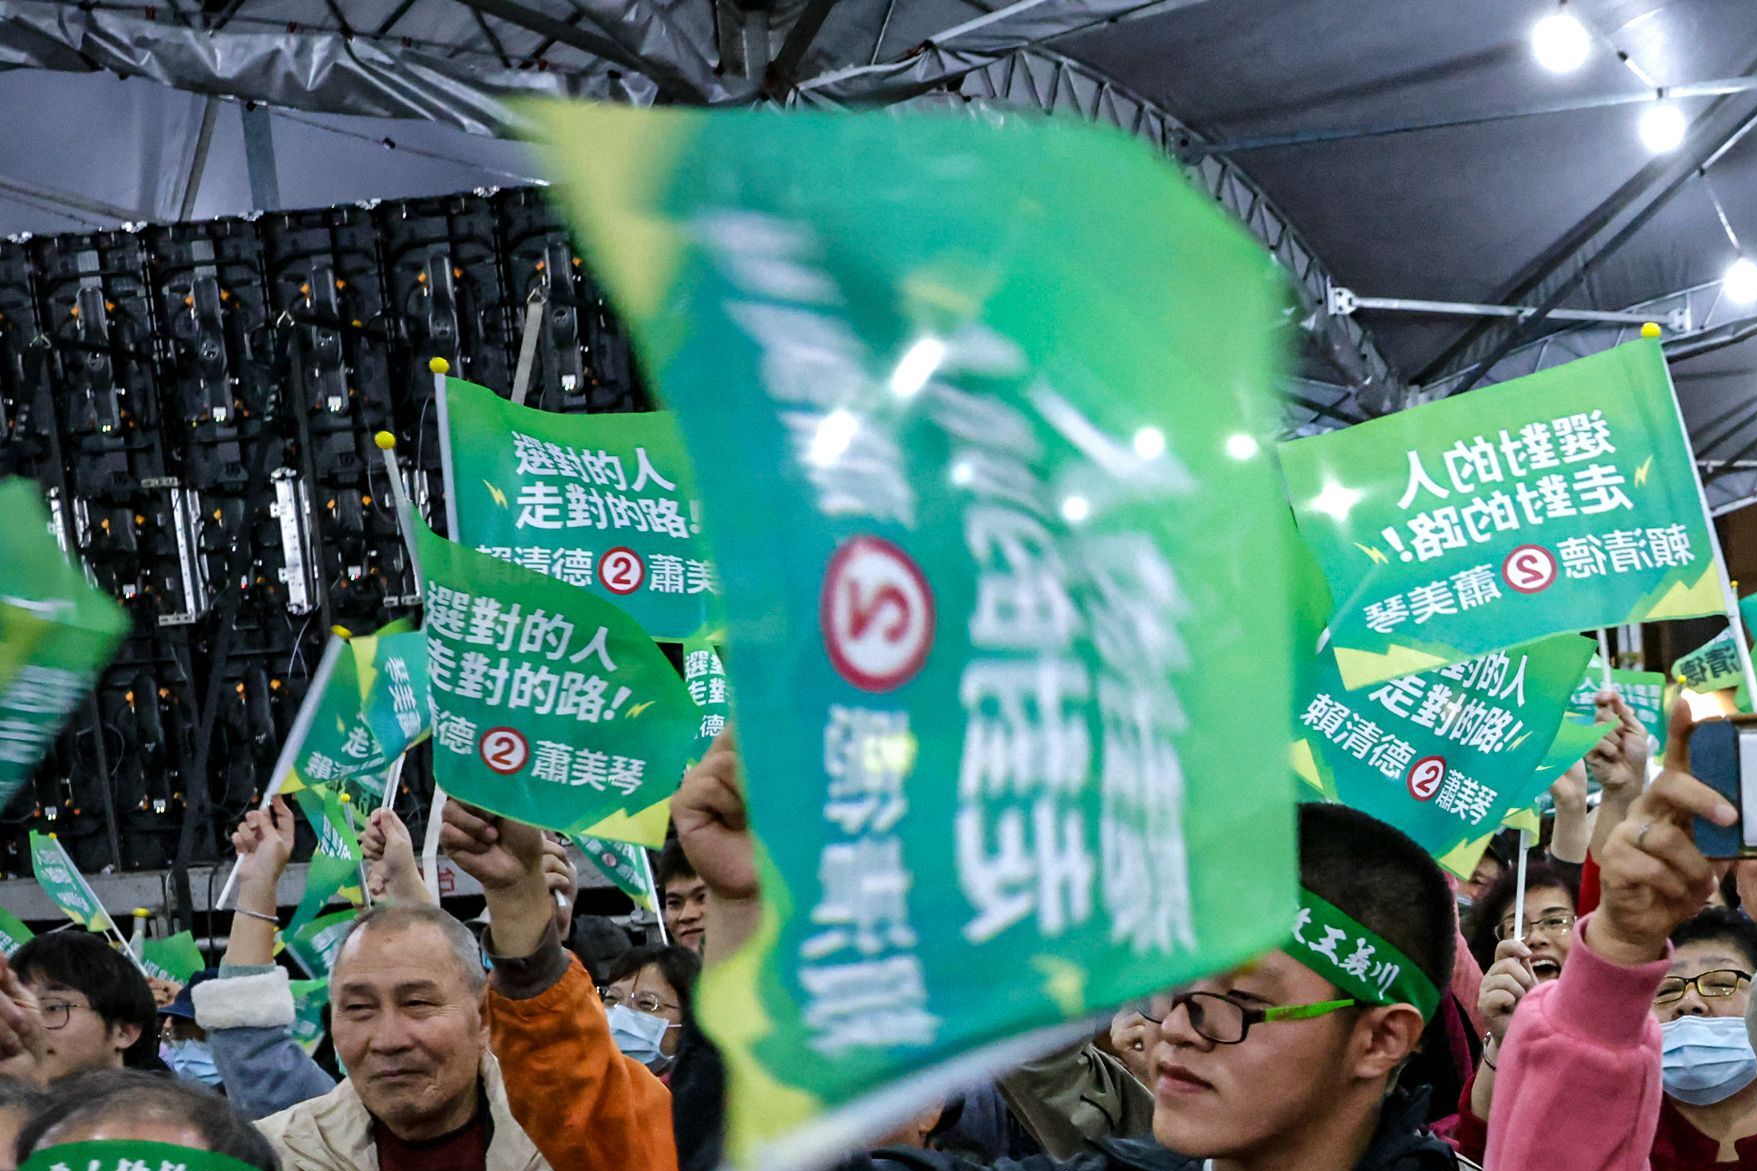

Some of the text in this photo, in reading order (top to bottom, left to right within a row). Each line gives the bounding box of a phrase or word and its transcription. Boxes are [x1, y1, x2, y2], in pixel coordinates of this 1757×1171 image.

[511, 430, 676, 492] 選對的人
[516, 481, 701, 539] 走對的路!
[427, 580, 618, 673] 選對的人
[427, 636, 633, 723] 走對的路!
[1367, 674, 1524, 754] 走對的路!
[1432, 650, 1528, 707] 對的人
[531, 739, 647, 796] 蕭美琴
[1300, 693, 1416, 779] 賴清德
[1435, 769, 1498, 826] 蕭美琴
